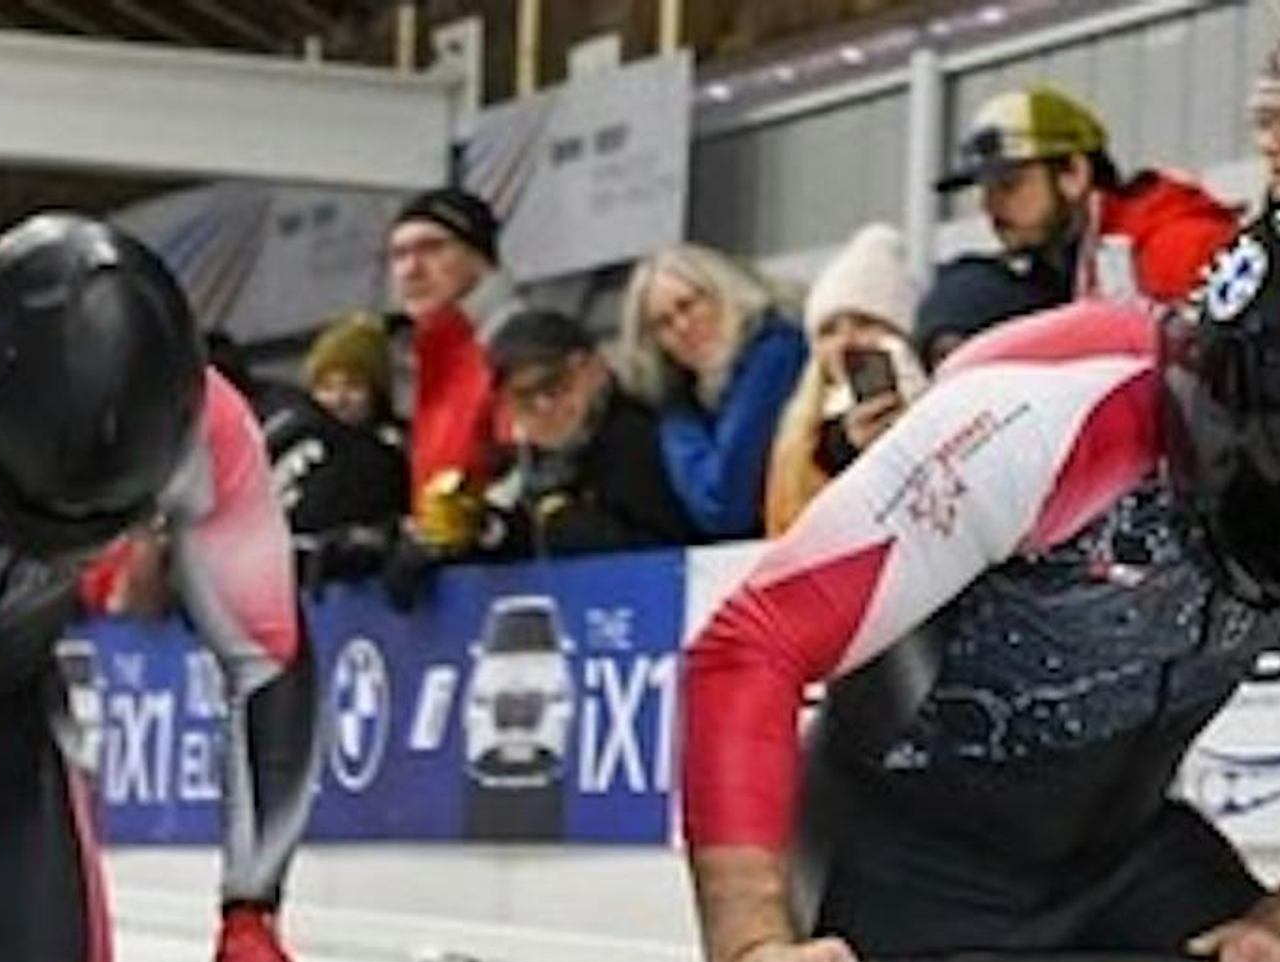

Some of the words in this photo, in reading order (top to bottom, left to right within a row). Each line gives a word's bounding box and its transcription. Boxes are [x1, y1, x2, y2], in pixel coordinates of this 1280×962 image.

[584, 608, 635, 650] THE
[103, 692, 175, 804] iX1
[578, 651, 678, 794] iX1
